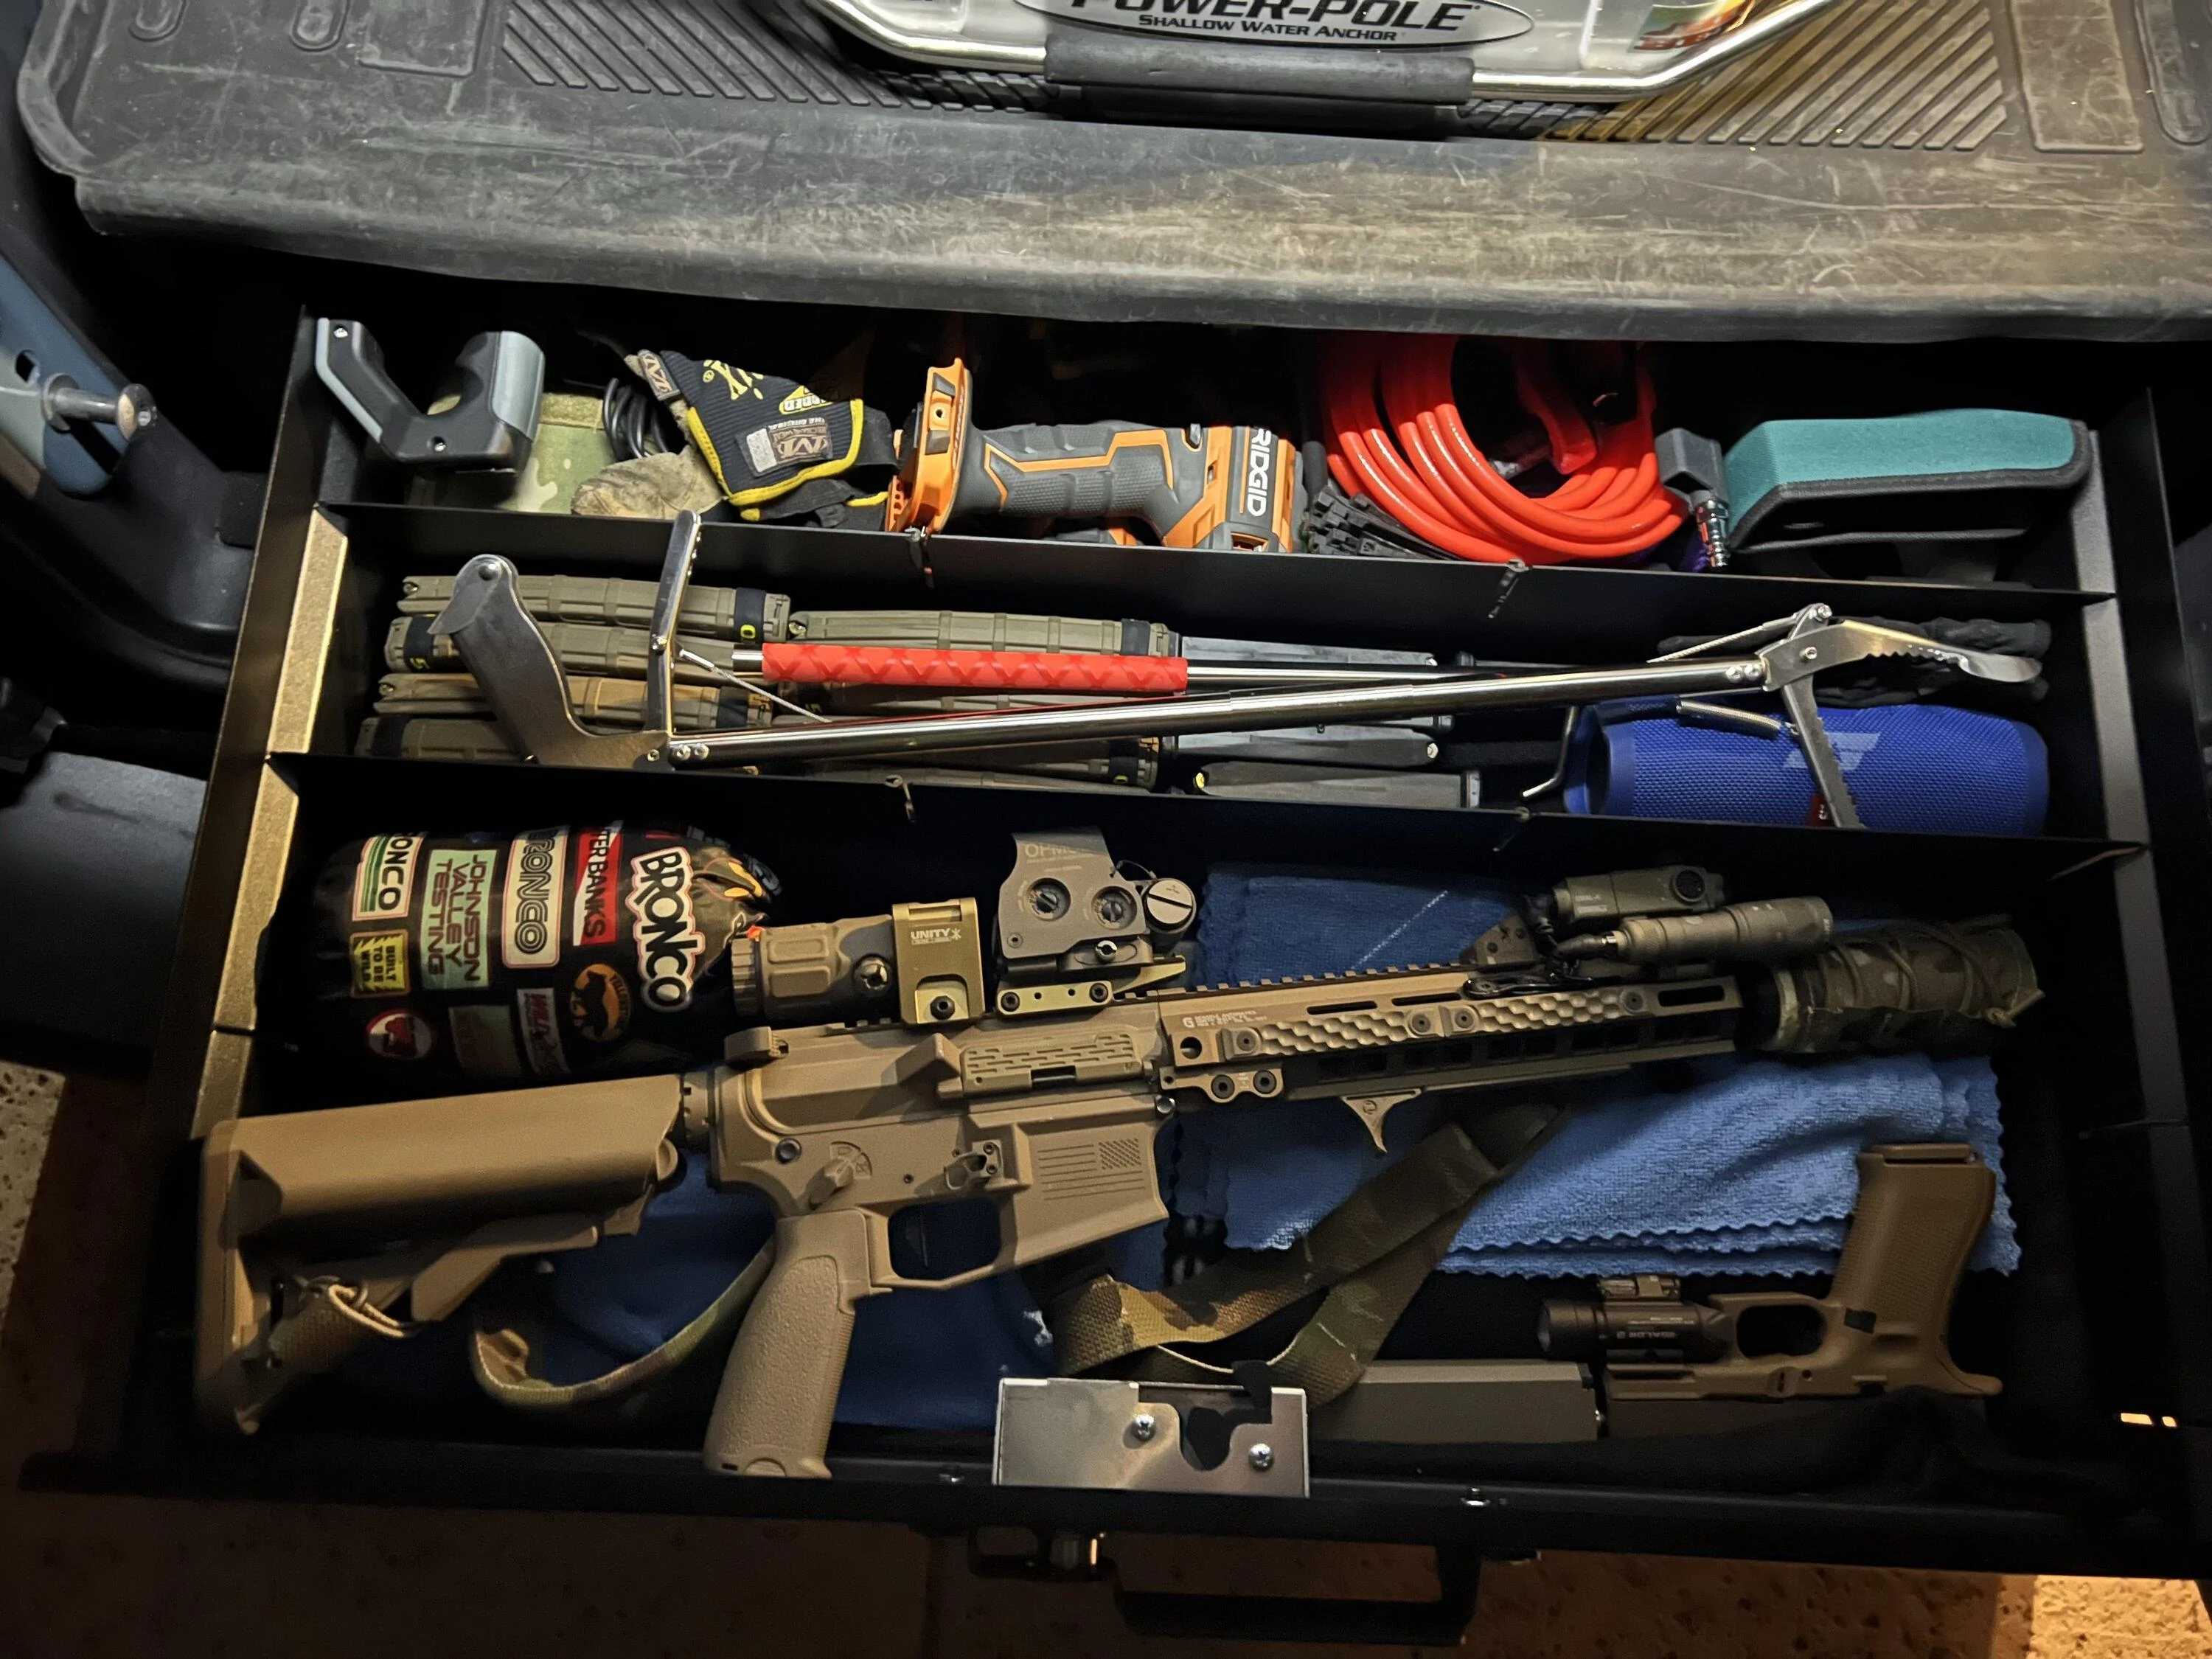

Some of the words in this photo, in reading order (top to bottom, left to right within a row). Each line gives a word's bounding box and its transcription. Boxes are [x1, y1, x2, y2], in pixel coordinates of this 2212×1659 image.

[1071, 0, 1472, 31] ER-POLE
[1139, 14, 1235, 31] SHALLOW
[1241, 21, 1310, 36] WATER
[1315, 26, 1397, 41] ANCHOR
[1247, 428, 1272, 517] RIDGID
[588, 828, 611, 861] TER
[378, 835, 413, 911] ONCO
[583, 860, 609, 938] BANKS
[428, 858, 453, 975] TESTING
[445, 863, 470, 967] VALLEY
[463, 854, 487, 982] JOHNSON
[633, 850, 698, 1006] BRONCO
[910, 927, 950, 939] UNITY
[375, 945, 383, 963] TO
[375, 966, 384, 983] BE
[386, 945, 397, 982] BUILT
